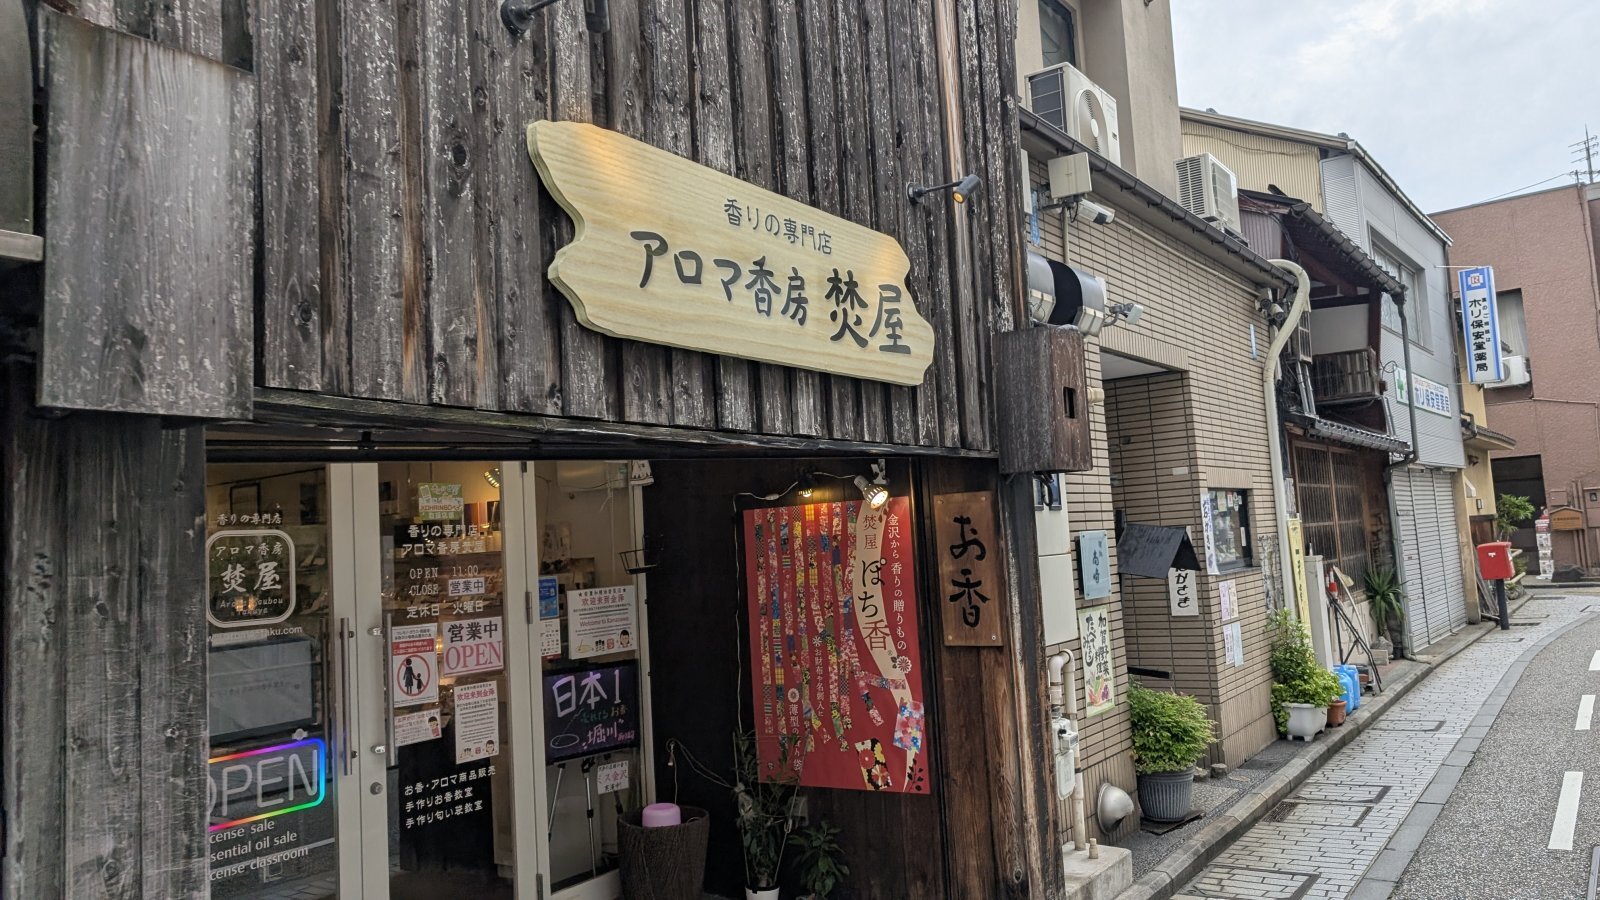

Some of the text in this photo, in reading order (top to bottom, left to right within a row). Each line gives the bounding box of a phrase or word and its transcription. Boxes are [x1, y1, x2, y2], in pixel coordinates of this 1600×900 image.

[724, 198, 832, 255] 香りの専門店
[1469, 299, 1488, 372] ホリ保安堂薬局
[217, 513, 282, 526] 香りの専門店
[408, 525, 479, 539] 香りの専門店
[216, 542, 283, 557] アロマ香房
[220, 561, 282, 594] 焚屋
[410, 565, 480, 580] OPEN 11:00
[888, 514, 907, 651] 金沢から香りの贈りもの
[949, 515, 990, 628] お香
[410, 583, 439, 597] CLOSE
[450, 580, 484, 595] 営業中
[1175, 568, 1190, 608] かさき
[407, 600, 485, 619] 定休日 火曜日
[858, 558, 890, 652] ぽち香
[448, 620, 498, 644] 営業中
[446, 641, 502, 670] OPEN
[404, 765, 496, 796] お香・アロマ商品販売
[405, 786, 473, 813] 手作りお香教室
[250, 819, 275, 834] sale
[255, 837, 270, 851] oil
[274, 831, 298, 846] sale
[250, 846, 309, 870] classroom
